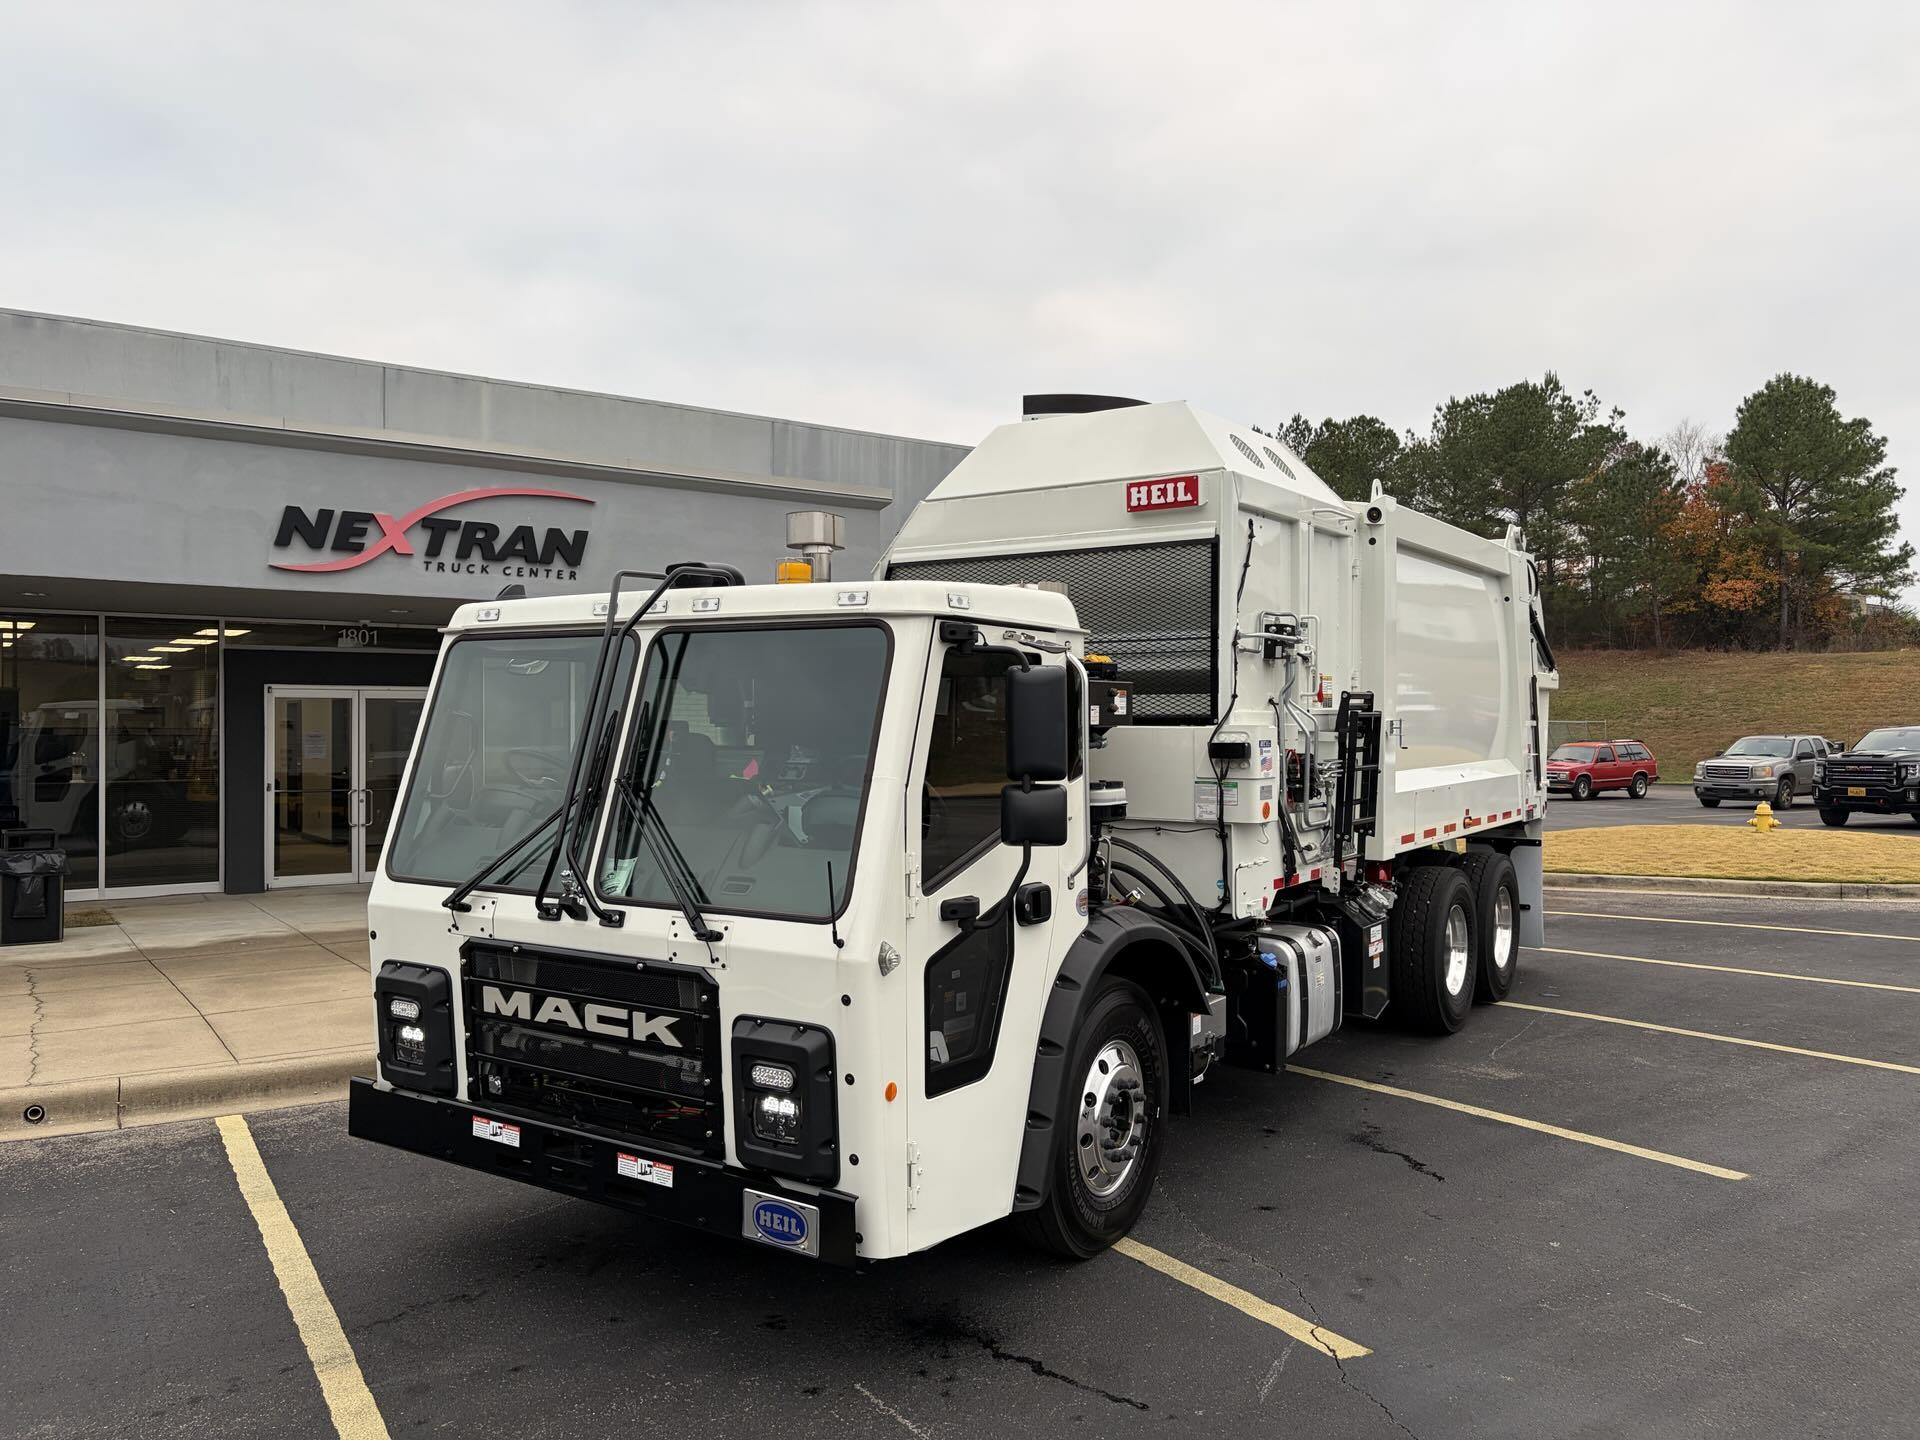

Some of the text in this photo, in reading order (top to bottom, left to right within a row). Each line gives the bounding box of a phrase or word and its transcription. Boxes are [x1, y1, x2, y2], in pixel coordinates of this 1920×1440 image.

[1130, 481, 1193, 506] HEIL
[273, 505, 590, 567] NEXTRAN
[423, 560, 578, 581] TRUCK CENTER
[338, 628, 378, 646] 1801
[482, 985, 684, 1048] MACK
[759, 1209, 801, 1236] HEIL
